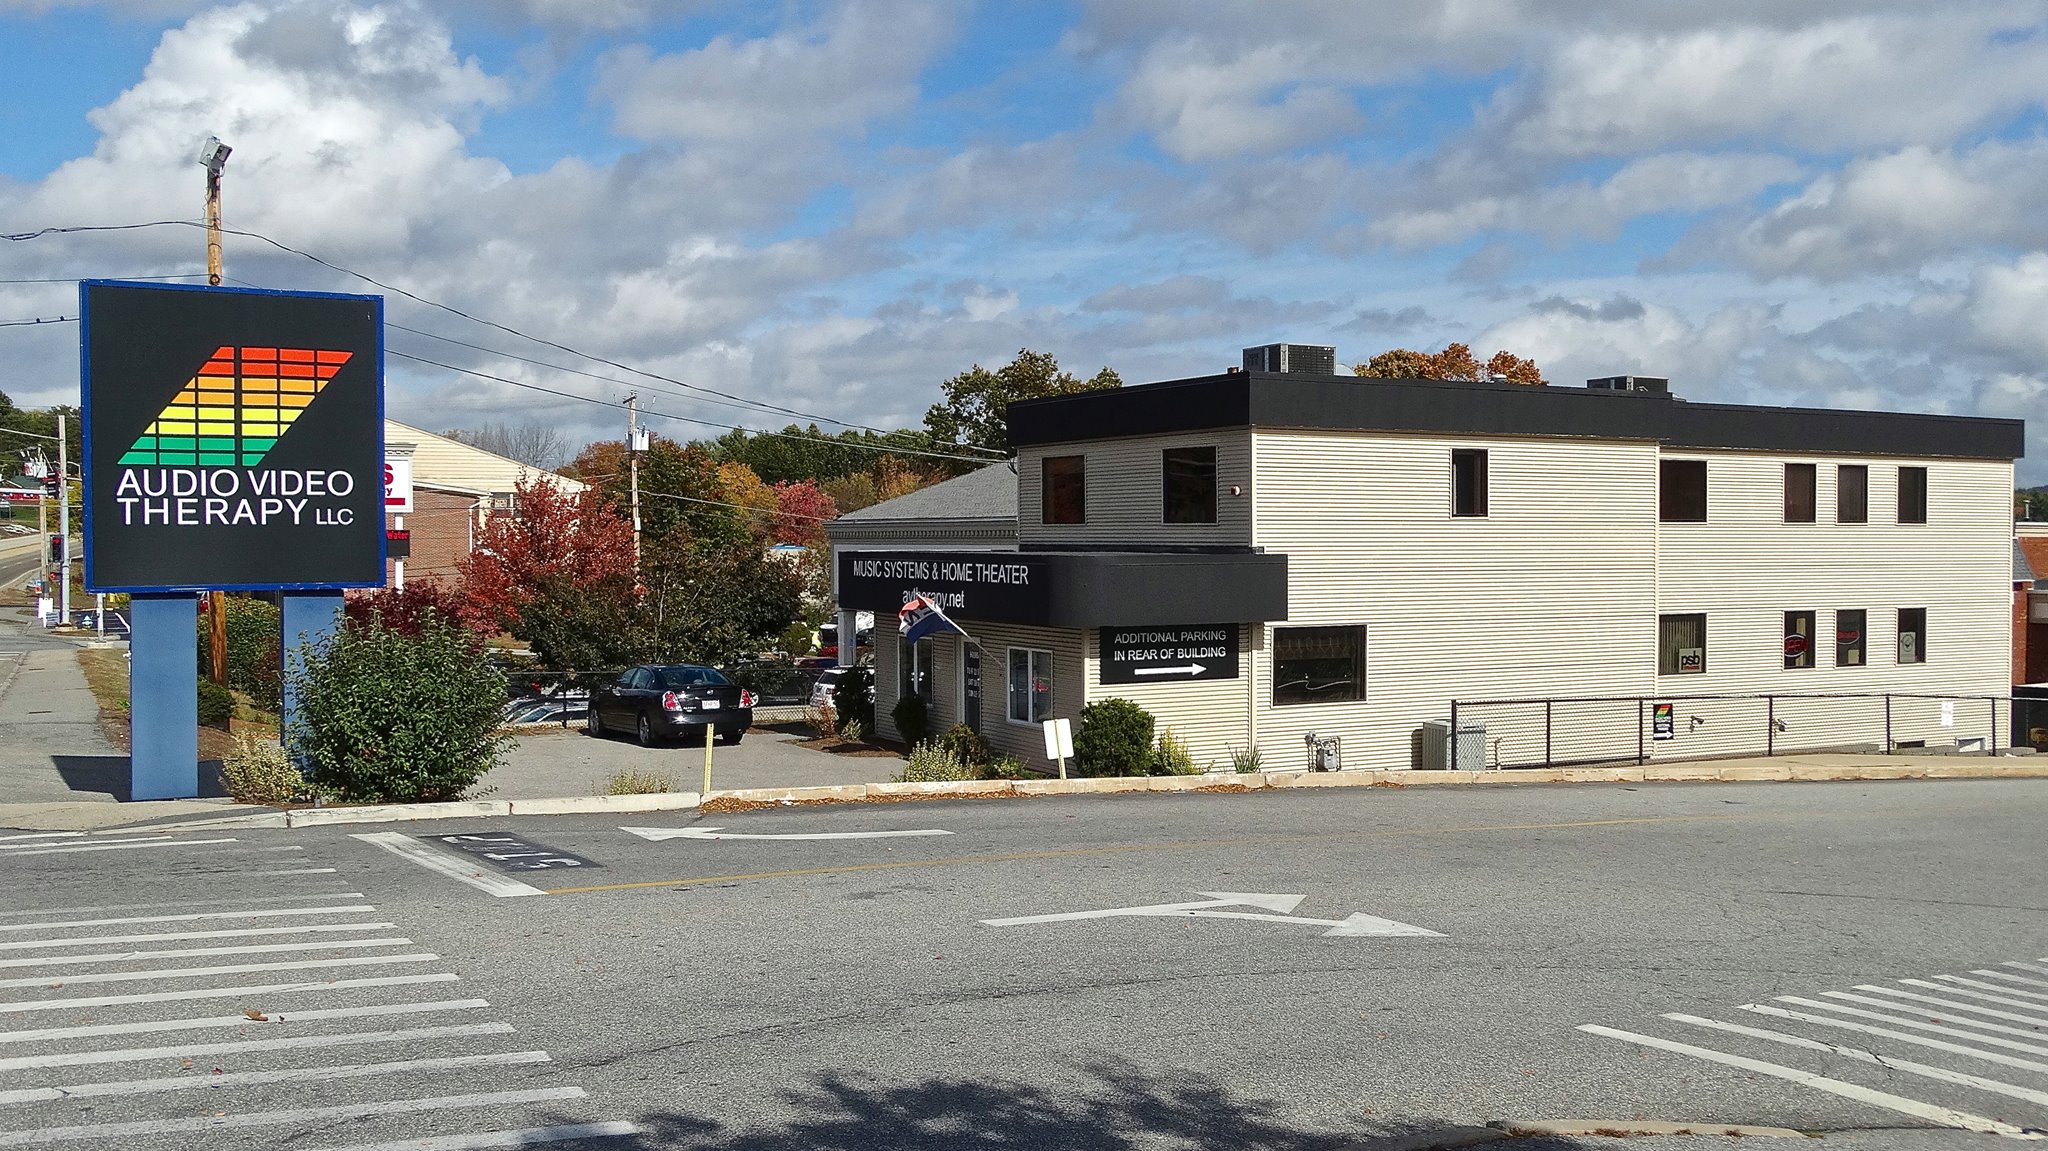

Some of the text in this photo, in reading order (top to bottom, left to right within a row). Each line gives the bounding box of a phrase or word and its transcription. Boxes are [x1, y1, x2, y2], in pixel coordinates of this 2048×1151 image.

[116, 468, 240, 497] AUDIO
[247, 469, 355, 497] VIDEO
[116, 497, 354, 525] THERAPY LLC
[853, 560, 1029, 585] MUSIC SYSTEMS & HOME THEATER
[1114, 630, 1227, 644] ADDITIONAL PARKING
[1114, 646, 1226, 661] IN REAR OF BUILDING
[1681, 650, 1700, 670] psb
